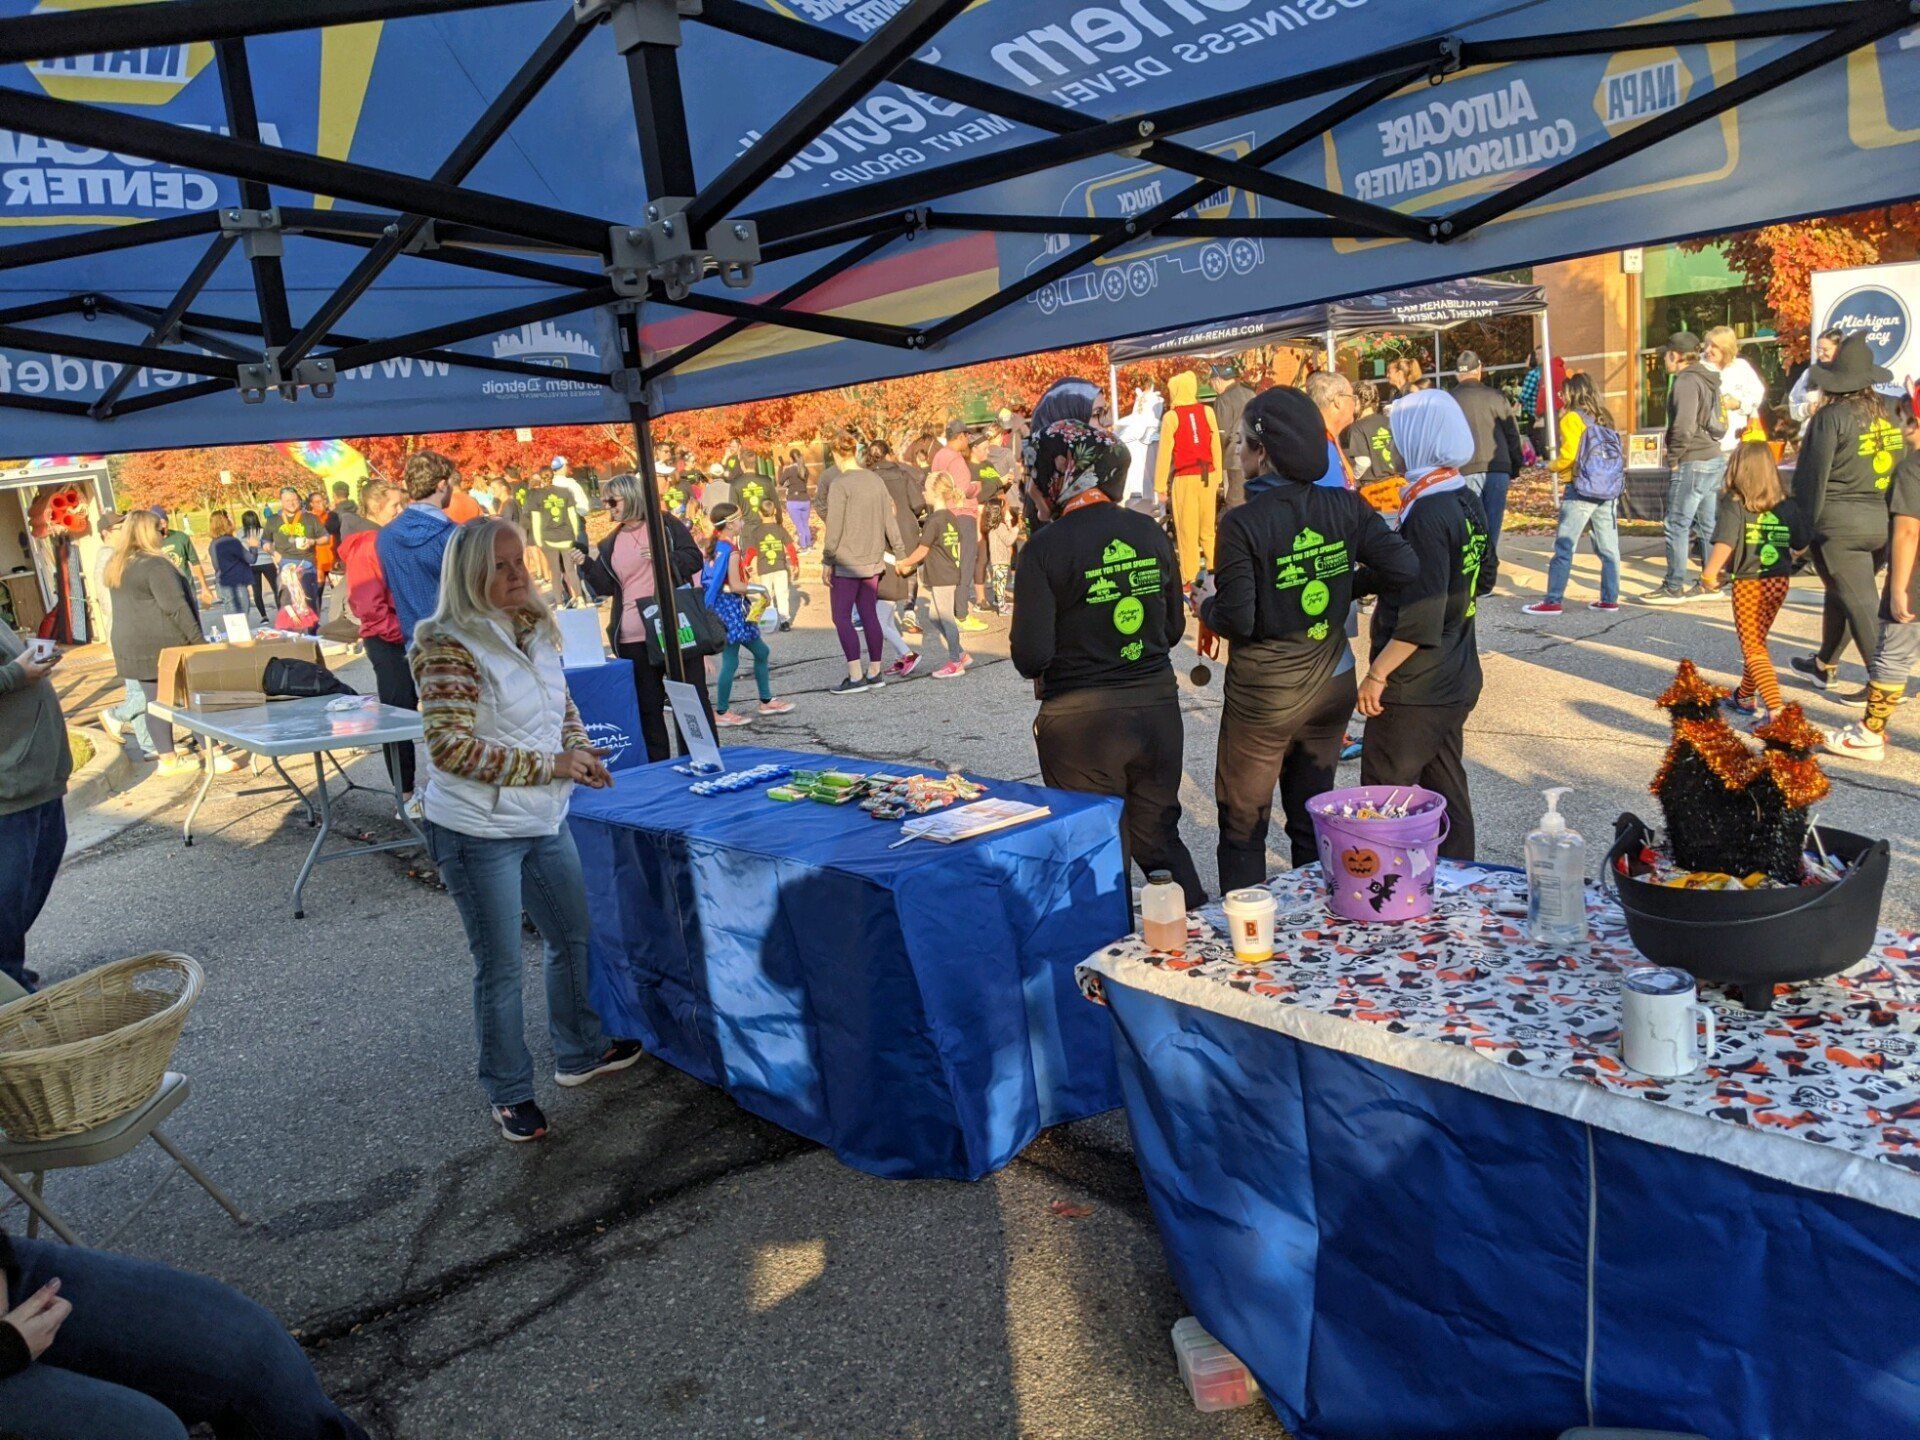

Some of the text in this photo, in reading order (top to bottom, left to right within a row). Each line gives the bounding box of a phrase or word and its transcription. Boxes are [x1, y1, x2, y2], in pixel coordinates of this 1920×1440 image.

[1449, 307, 1493, 319] THERAPY
[1832, 313, 1900, 332] Michigan
[1102, 565, 1114, 575] YOU
